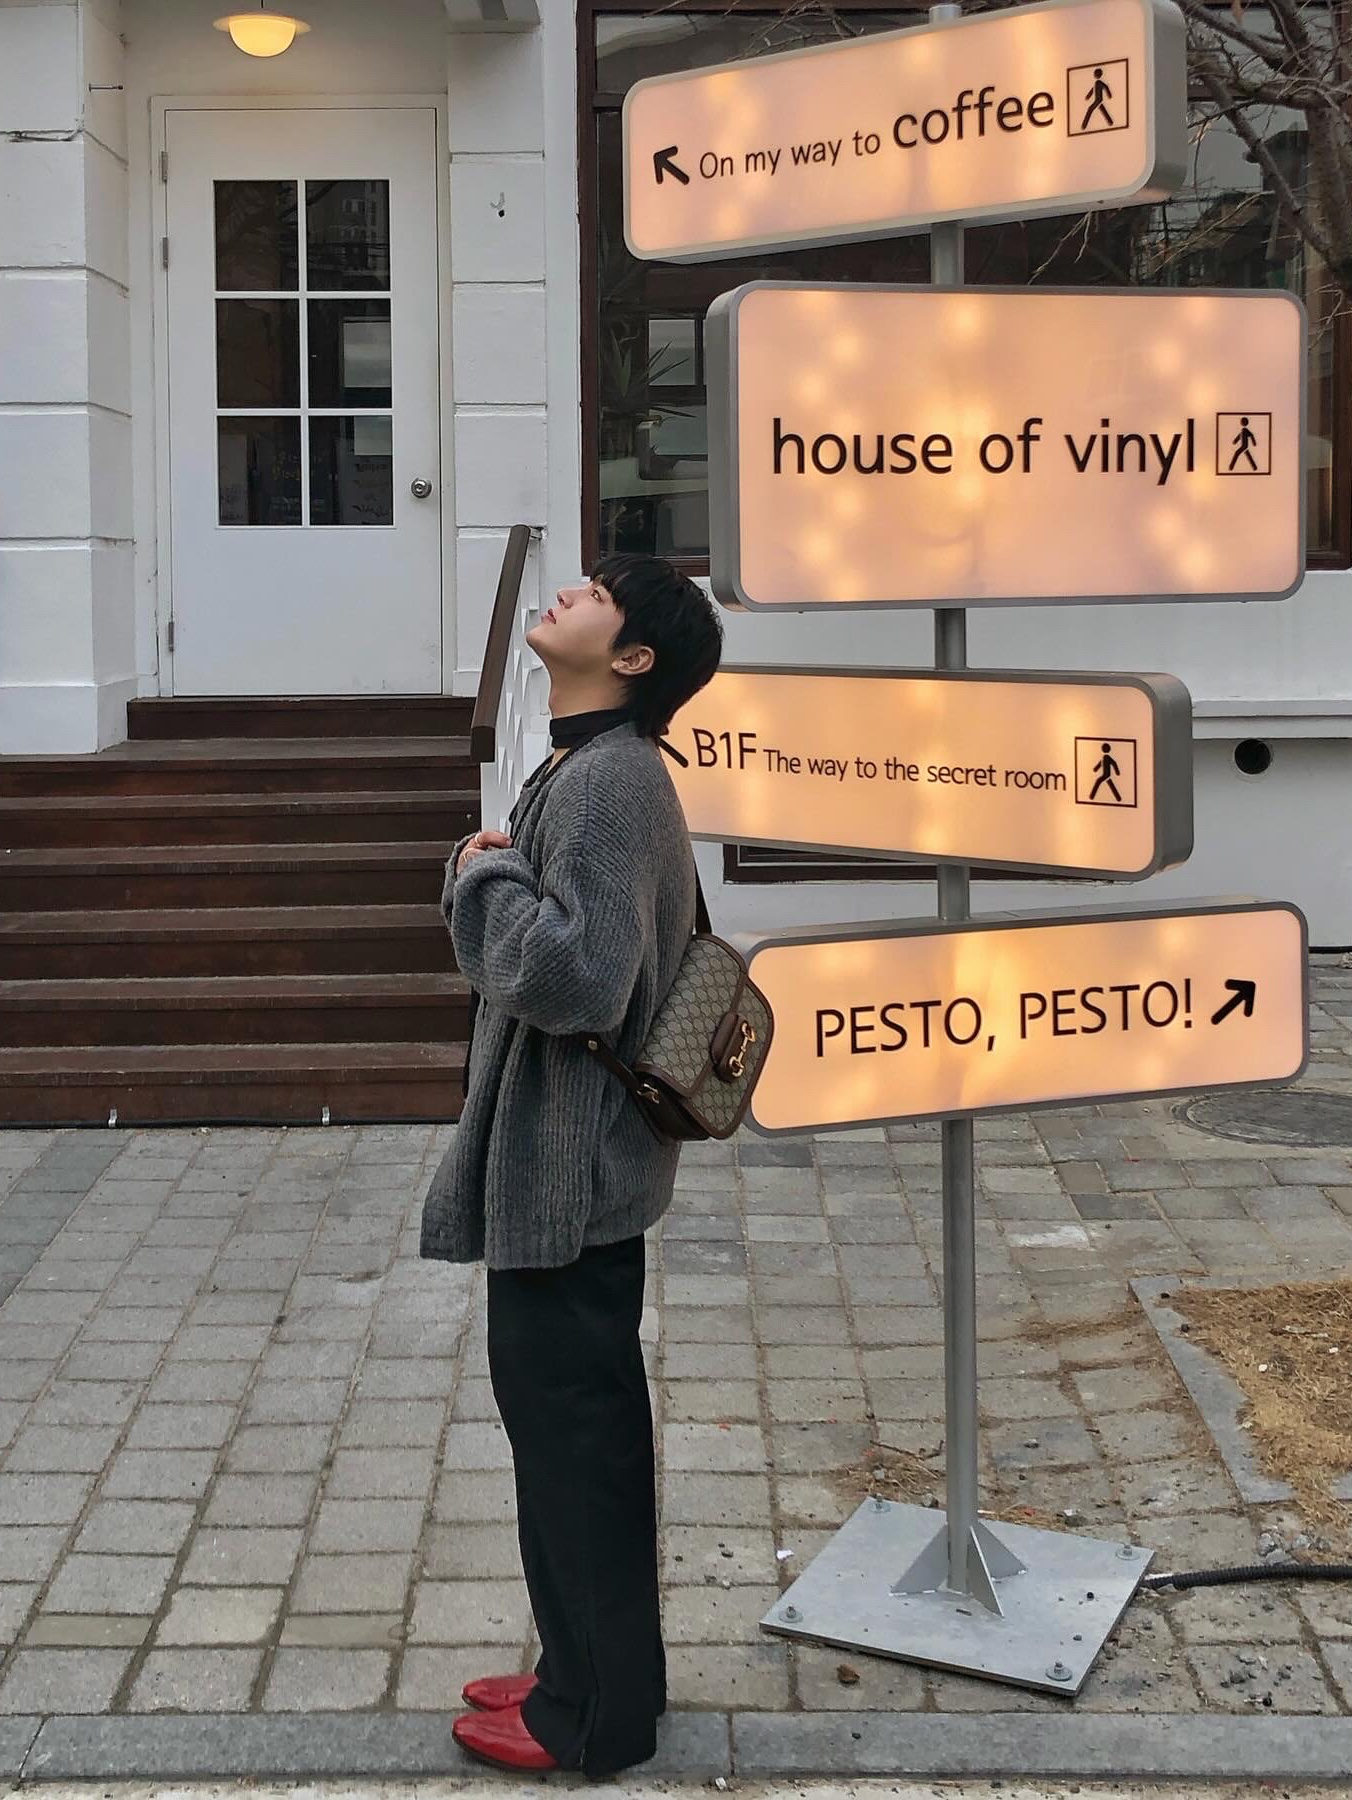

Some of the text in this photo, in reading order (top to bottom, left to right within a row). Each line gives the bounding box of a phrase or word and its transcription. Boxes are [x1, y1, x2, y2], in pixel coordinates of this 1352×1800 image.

[699, 85, 1055, 180] On my way to coffee
[772, 417, 1195, 487] house of vinyl
[691, 727, 1067, 791] B1F The way to the secret room
[815, 977, 1193, 1058] PESTO, PESTO!
